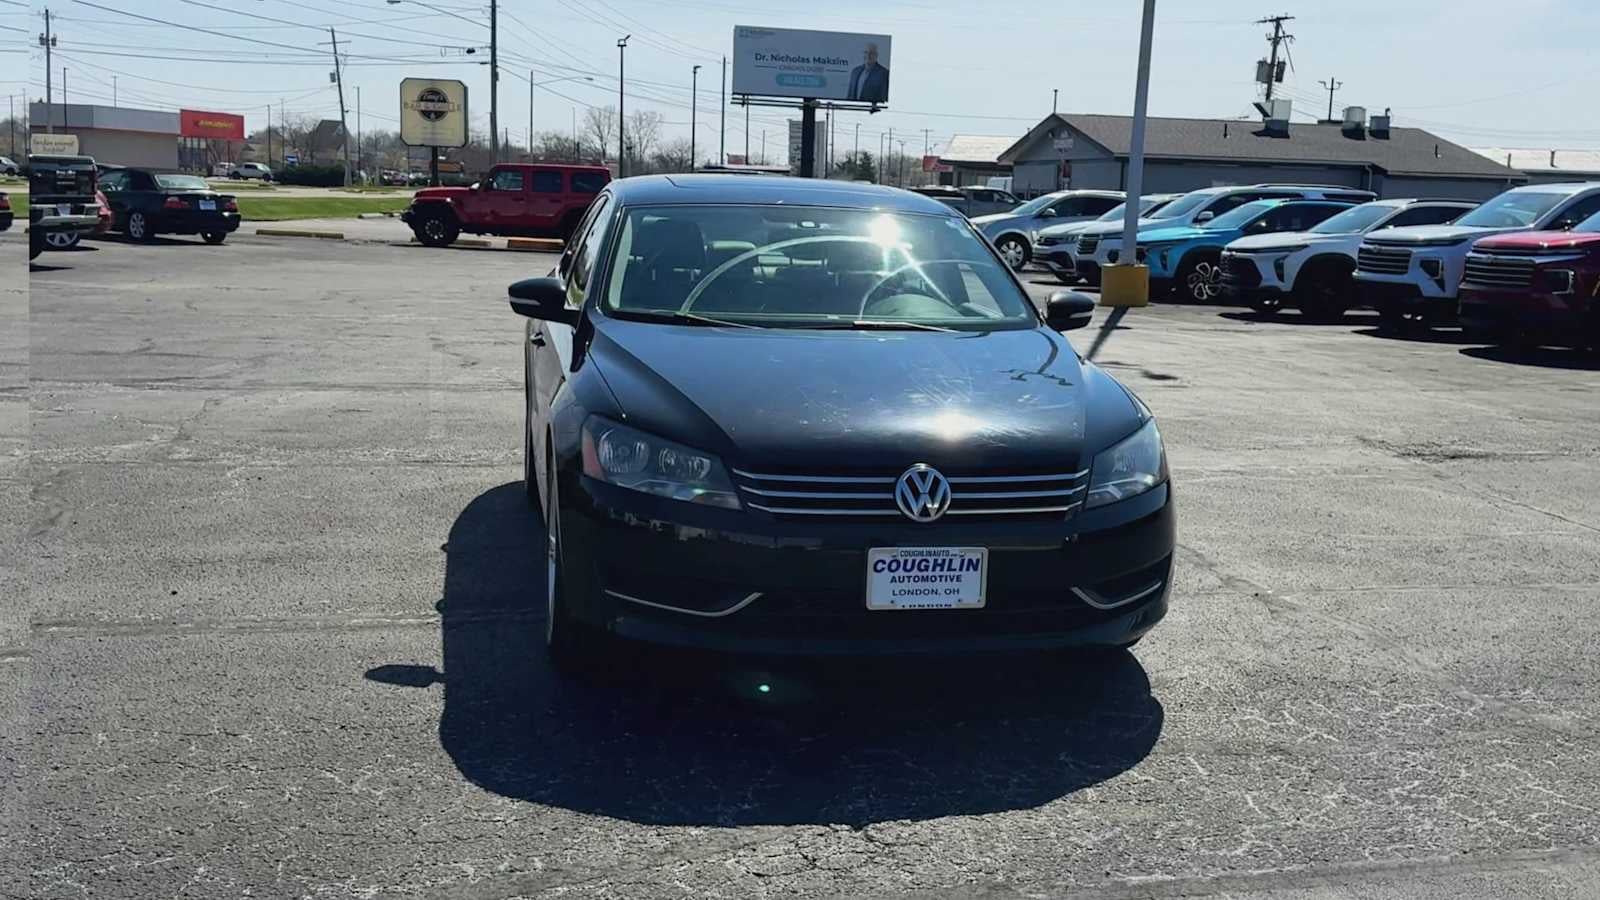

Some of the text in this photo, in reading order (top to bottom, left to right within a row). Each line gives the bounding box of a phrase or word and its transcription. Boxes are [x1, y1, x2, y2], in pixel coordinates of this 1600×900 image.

[754, 52, 769, 62] Dr.
[770, 53, 811, 64] Nicholas
[873, 558, 981, 573] COUGHLIN
[890, 574, 962, 584] AUTOMOTIVE
[944, 588, 960, 596] OH
